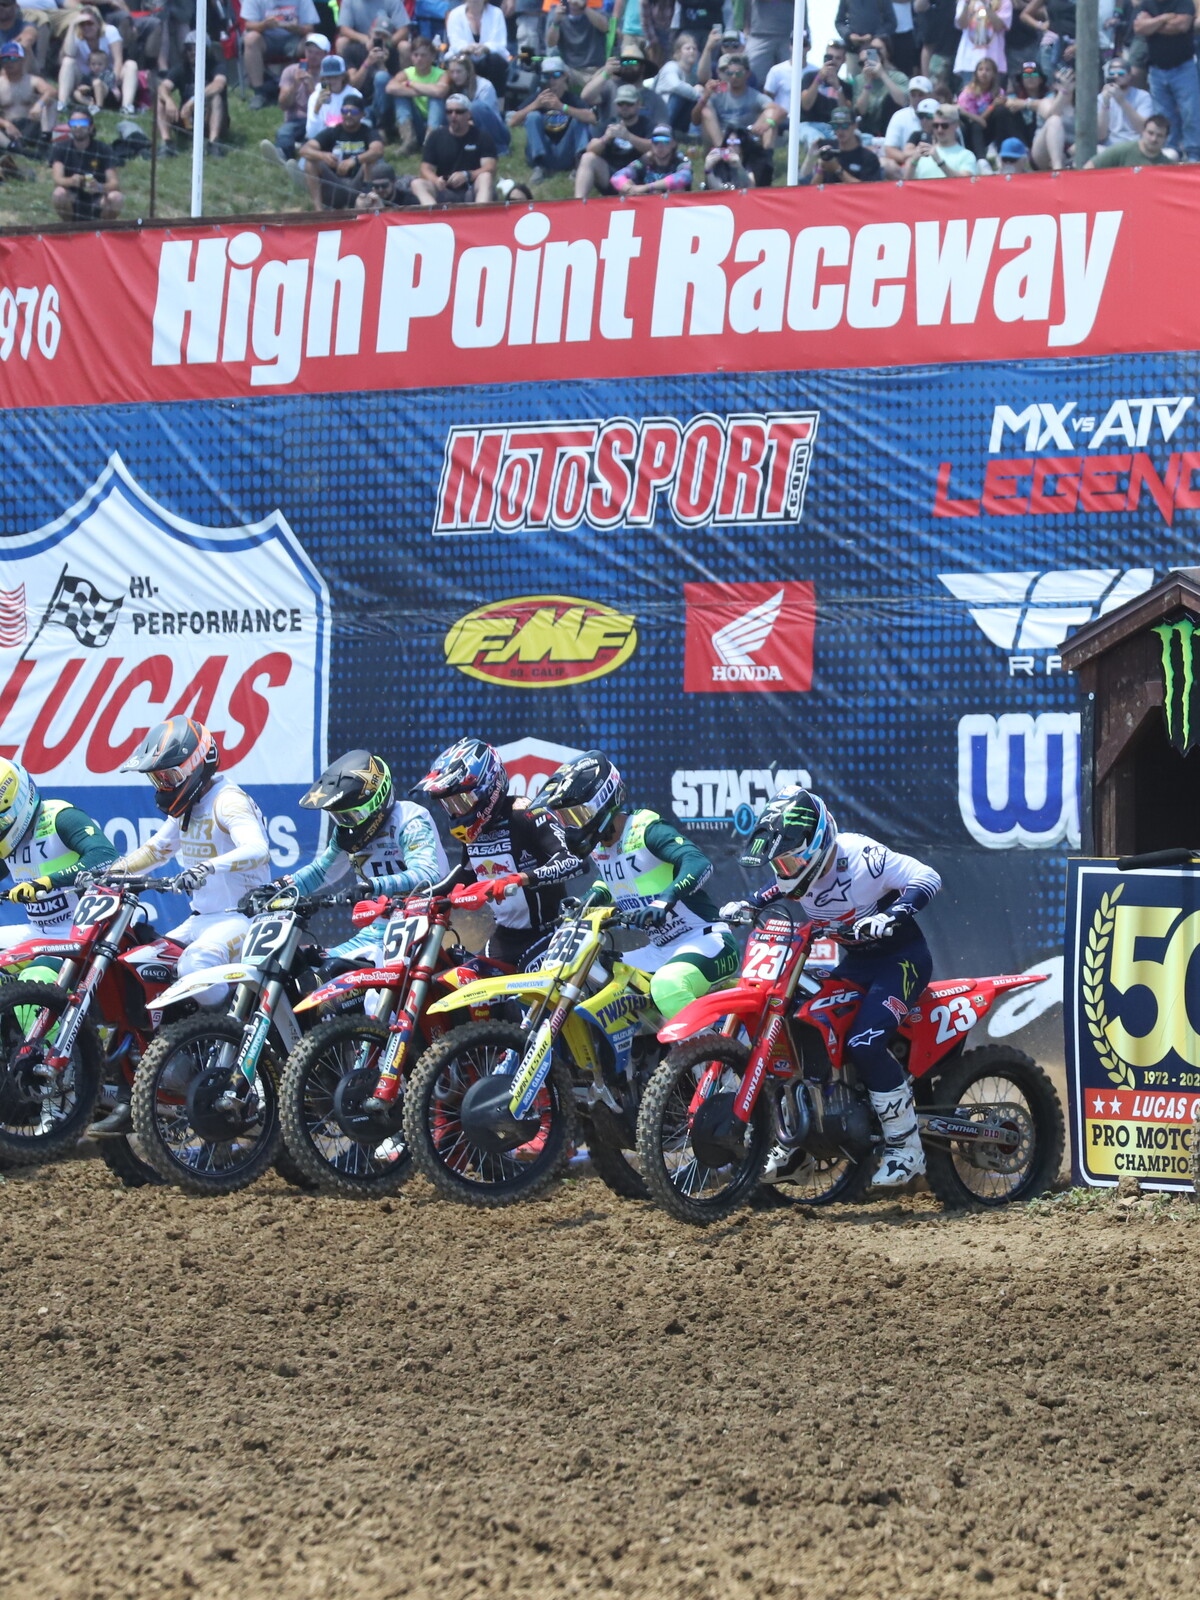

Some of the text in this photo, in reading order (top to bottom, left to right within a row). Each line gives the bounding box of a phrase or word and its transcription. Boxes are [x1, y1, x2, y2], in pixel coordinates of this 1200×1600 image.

[151, 203, 1124, 386] High Point Raceway
[988, 401, 1077, 453] MX
[1087, 397, 1194, 450] ATV
[129, 575, 159, 599] HI-
[133, 609, 302, 635] PERFORMANCE
[447, 608, 637, 665] FMF
[711, 665, 784, 681] HONDA
[76, 896, 115, 926] 82
[244, 921, 282, 957] 12
[384, 919, 420, 961] 51
[142, 969, 167, 977] BASCO
[742, 943, 793, 981] 23
[931, 985, 970, 999] HONDA
[65, 1009, 86, 1052] DUNLOP
[930, 996, 978, 1045] 23
[742, 1057, 764, 1112] DUNLOP
[1143, 1071, 1169, 1085] 1972
[1132, 1095, 1186, 1120] LUCAS
[1091, 1123, 1130, 1148] PRO
